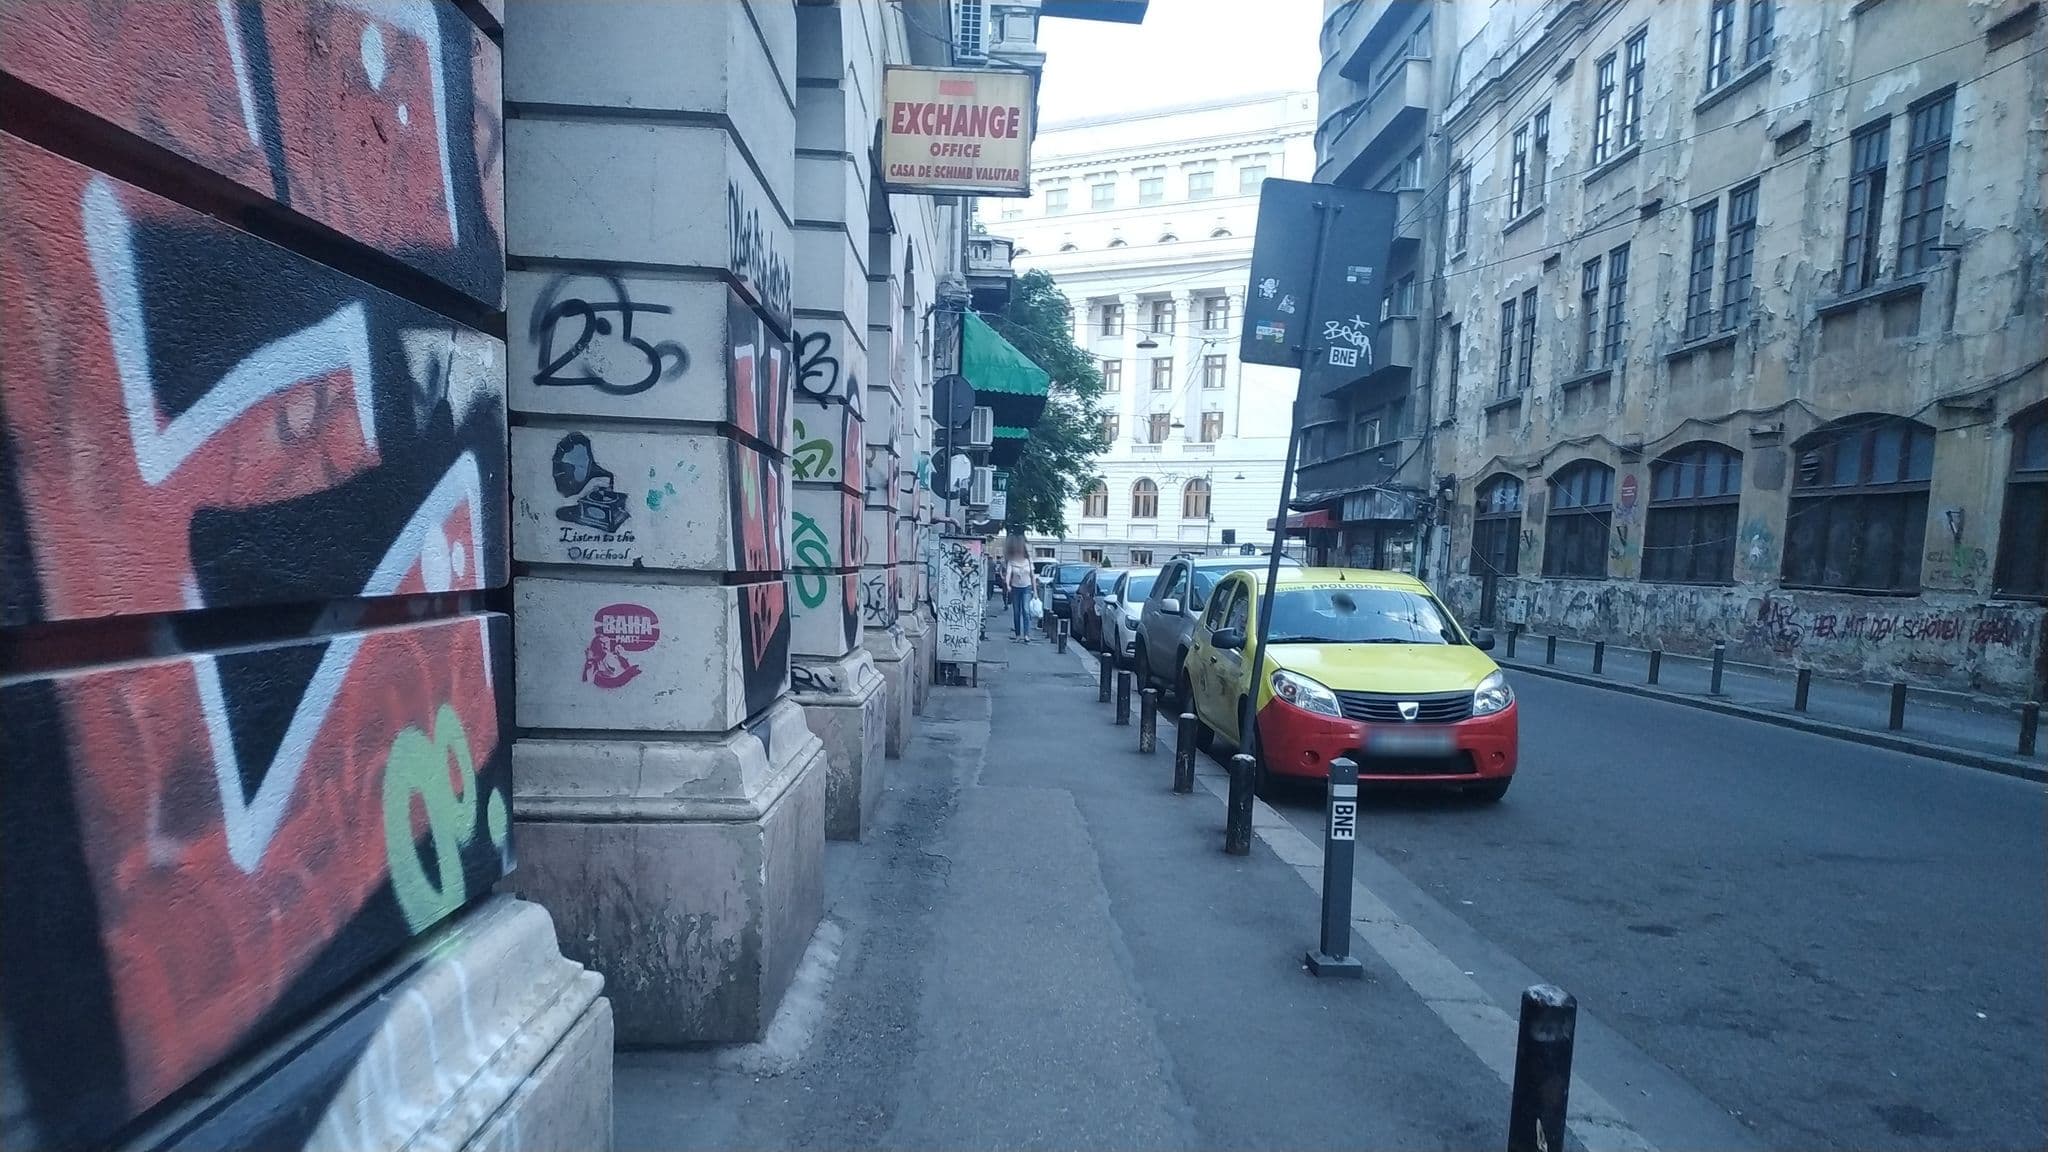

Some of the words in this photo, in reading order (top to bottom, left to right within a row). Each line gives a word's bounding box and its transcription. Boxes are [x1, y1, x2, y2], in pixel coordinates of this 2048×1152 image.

[891, 102, 1020, 139] EXCHANGE
[930, 142, 981, 158] OFFICE
[890, 163, 915, 177] CASA
[918, 165, 931, 178] DE
[933, 165, 973, 180] SCHIMB
[976, 167, 1019, 182] VALUTAR
[1331, 347, 1356, 366] BNE
[560, 526, 601, 542] Listen
[602, 534, 615, 542] to
[617, 530, 635, 542] the
[1333, 804, 1355, 838] BNE
